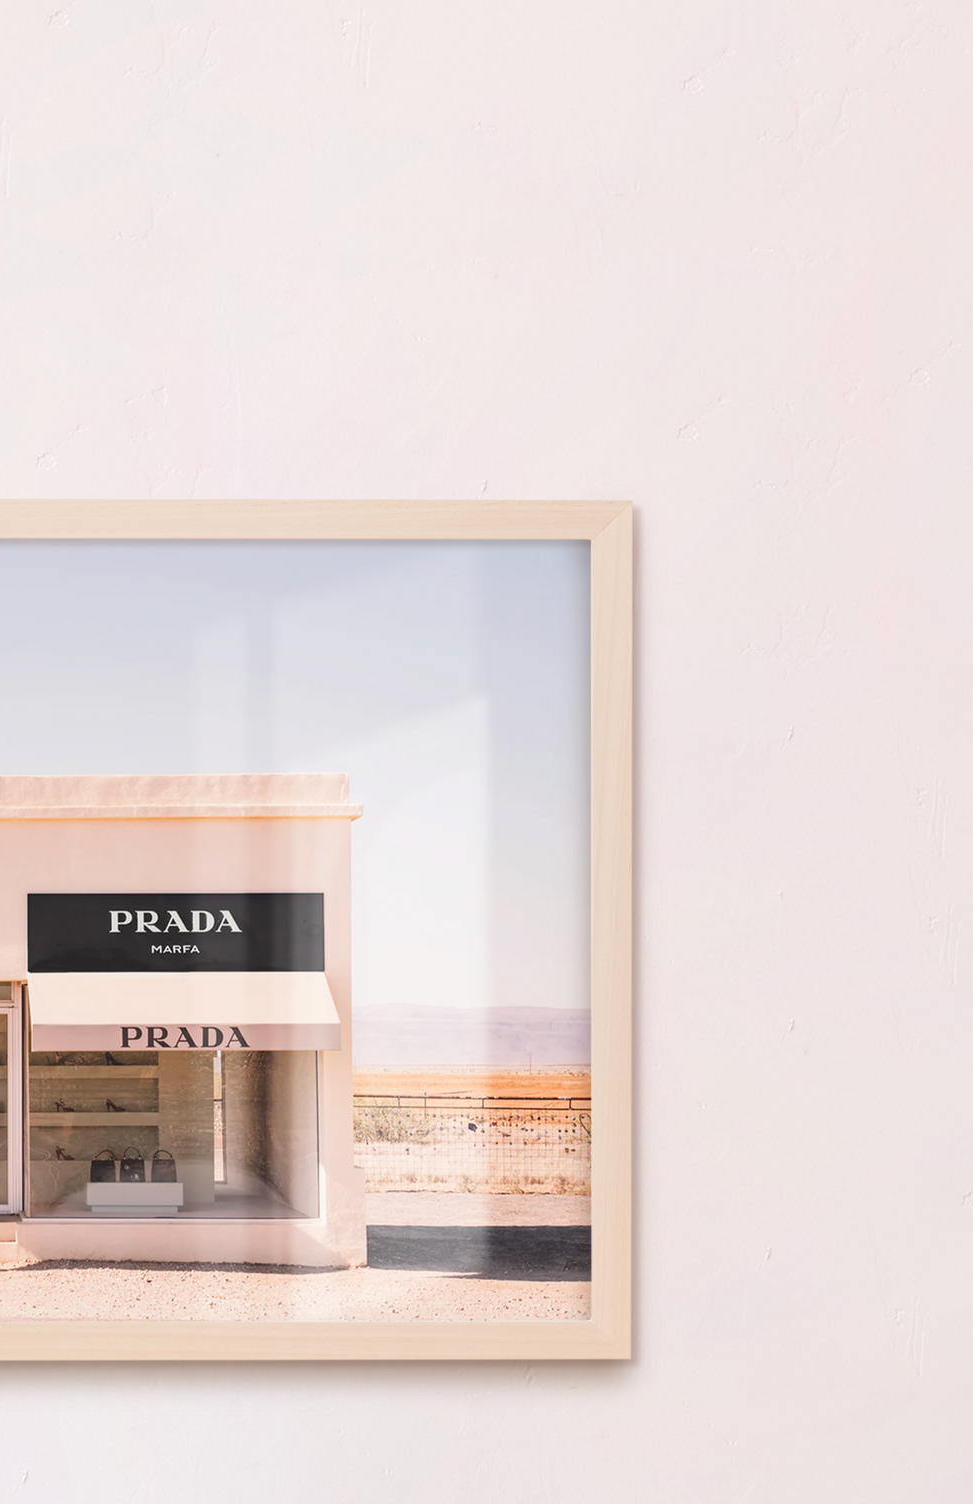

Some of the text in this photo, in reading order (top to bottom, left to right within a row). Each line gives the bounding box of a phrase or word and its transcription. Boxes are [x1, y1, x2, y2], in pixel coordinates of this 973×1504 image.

[108, 910, 242, 933] PRADA
[151, 945, 201, 954] MARFA
[120, 1026, 251, 1049] PRADA
